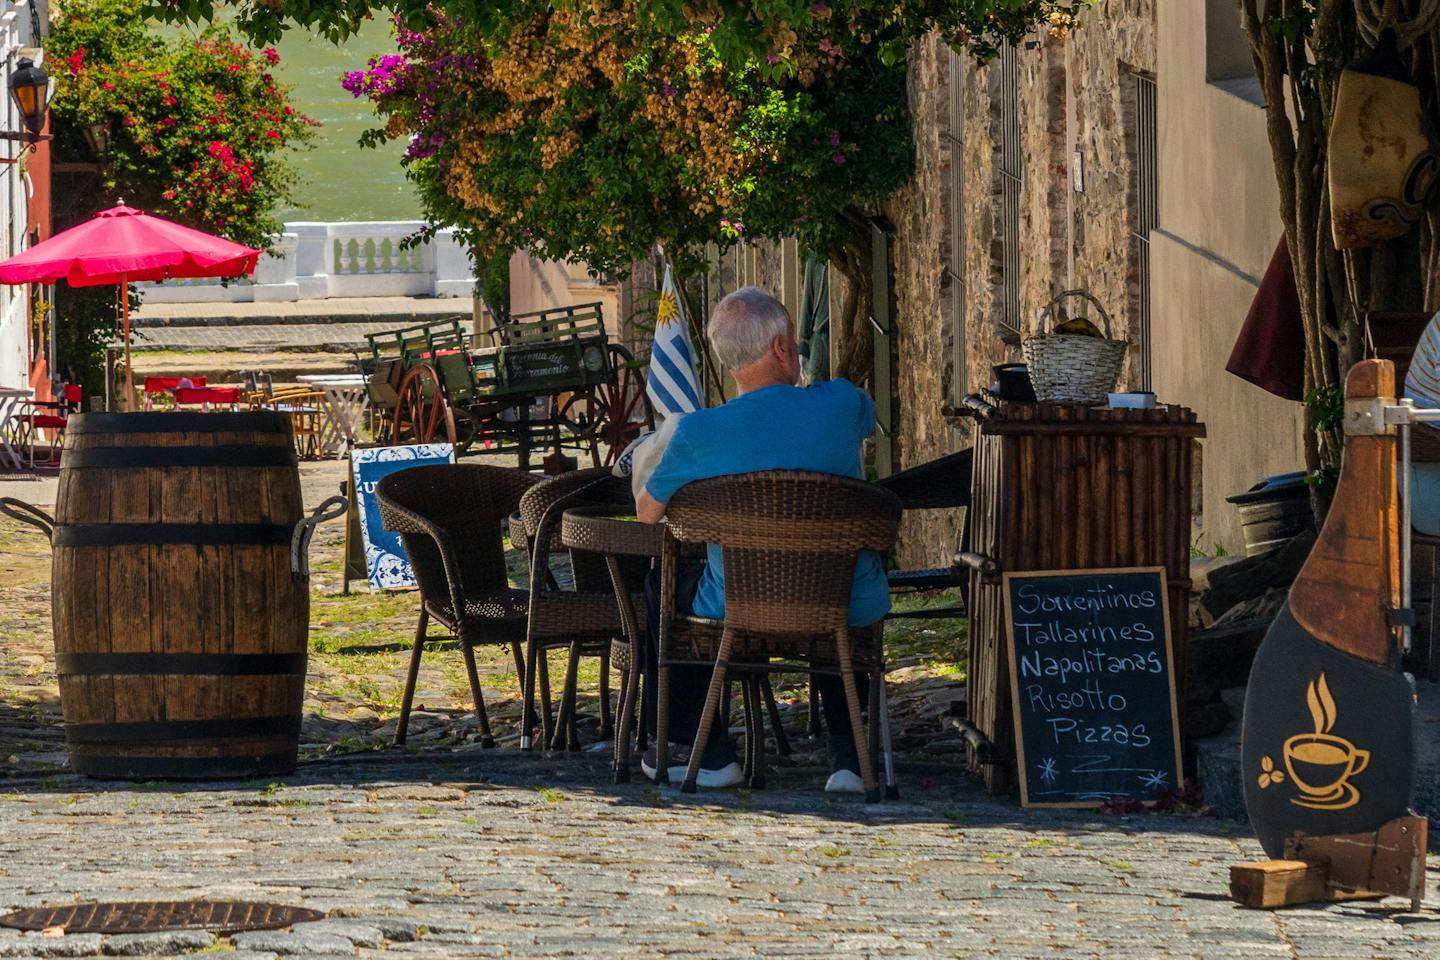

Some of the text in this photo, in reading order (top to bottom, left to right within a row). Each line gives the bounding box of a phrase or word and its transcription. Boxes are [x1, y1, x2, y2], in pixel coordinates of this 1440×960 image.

[1017, 583, 1157, 614] Sorrentinos
[1015, 621, 1155, 646] Tallarines
[1021, 647, 1163, 683] Napolitanas
[1025, 679, 1127, 713] Risotto
[1046, 717, 1152, 748] Pizzas
